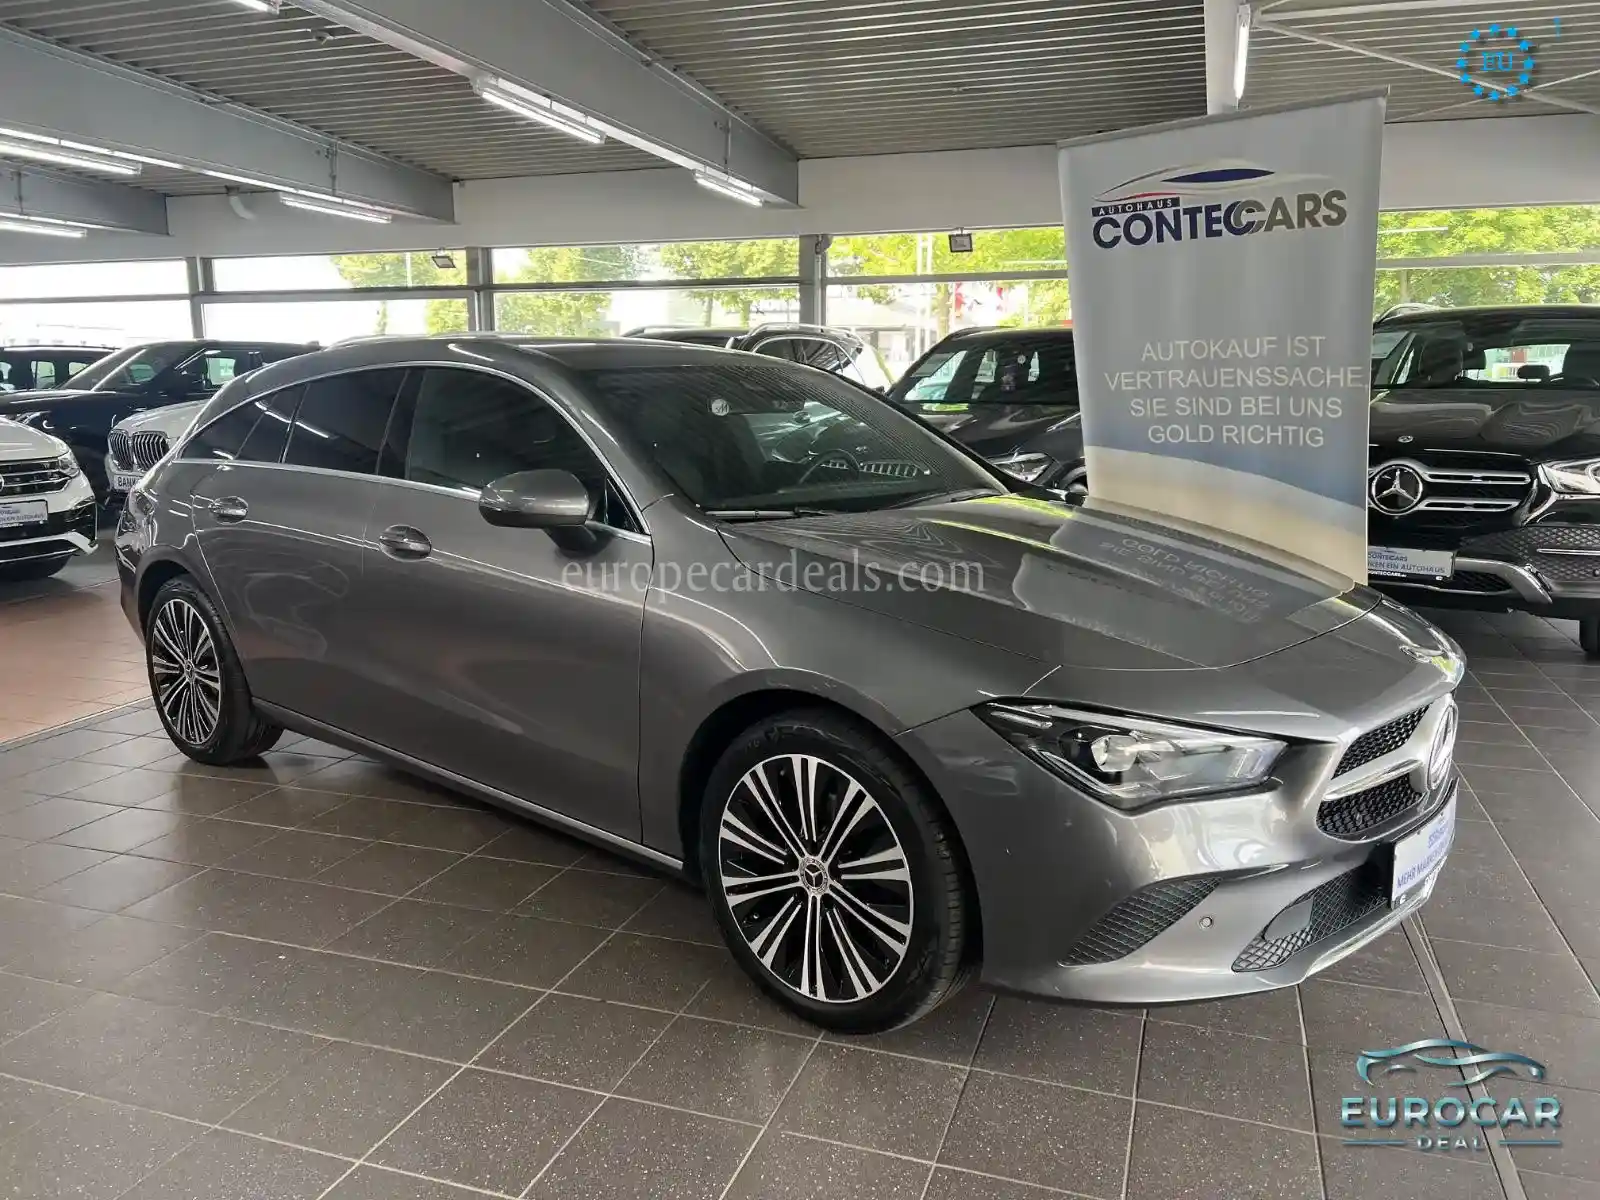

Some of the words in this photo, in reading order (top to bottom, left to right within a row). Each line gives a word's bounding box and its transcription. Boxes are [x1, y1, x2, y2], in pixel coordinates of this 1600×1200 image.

[1097, 198, 1173, 216] AUTOHAUS
[1140, 337, 1277, 362] AUTOKAUF
[1287, 335, 1326, 358] IST
[1129, 397, 1168, 418] SIE
[1175, 397, 1232, 417] SIND
[1240, 397, 1281, 416] BEI
[1289, 397, 1343, 418] UNS
[1148, 425, 1214, 444] GOLD
[1222, 425, 1324, 447] RICHTIG
[1400, 564, 1446, 573] AUTOHAUS
